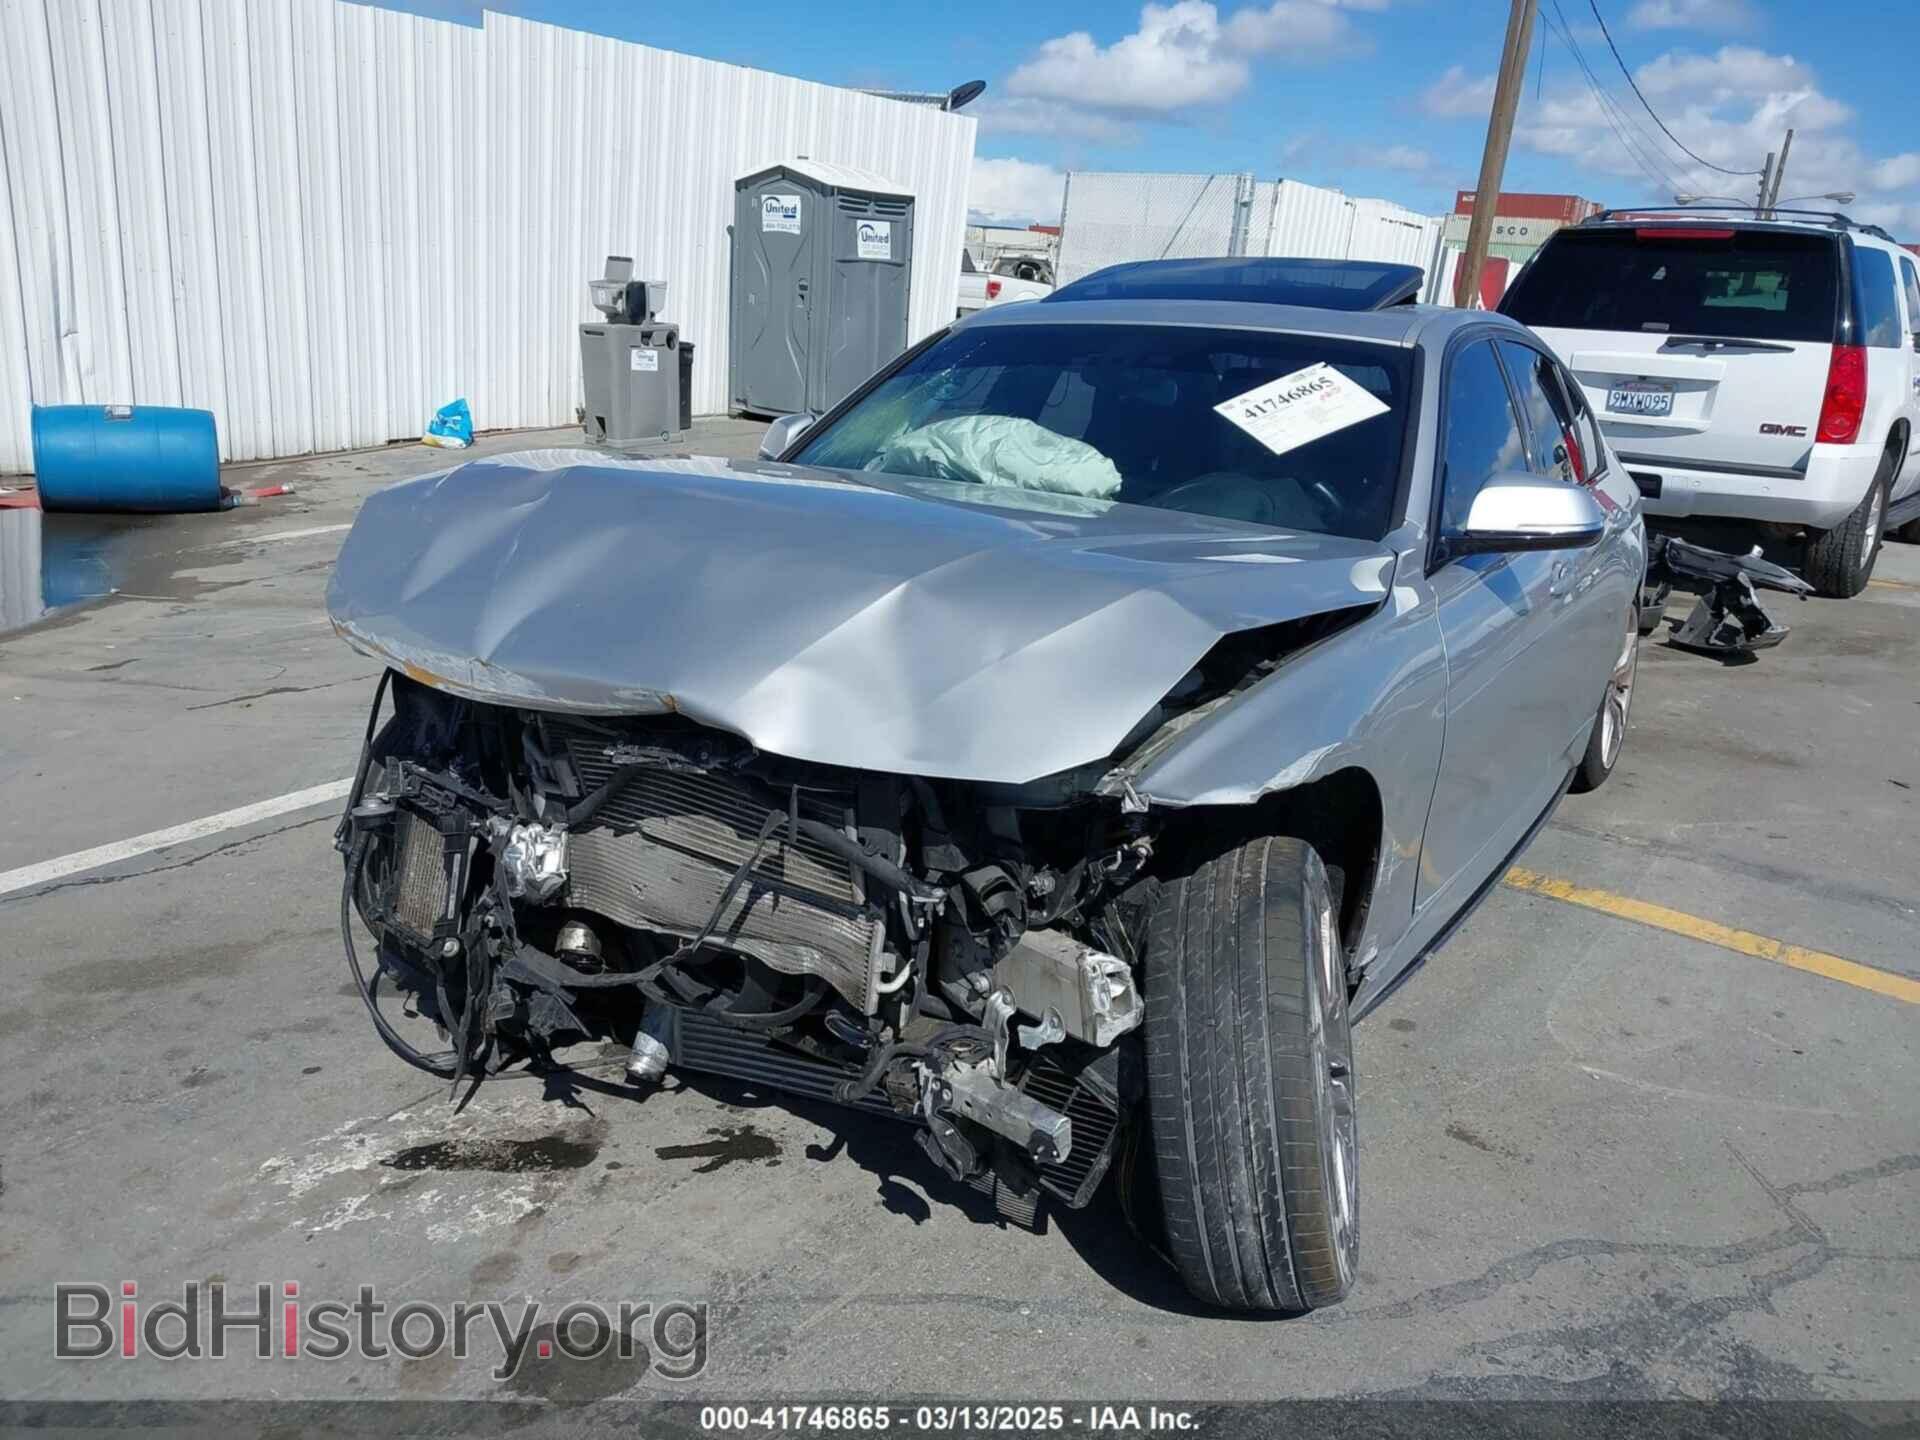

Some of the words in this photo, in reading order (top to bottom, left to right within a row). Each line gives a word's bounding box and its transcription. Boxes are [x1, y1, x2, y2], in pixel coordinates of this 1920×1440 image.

[765, 203, 797, 214] United
[861, 231, 889, 244] United
[1244, 376, 1335, 420] 41746865
[1608, 391, 1669, 411] 9MXW095
[1759, 423, 1807, 437] GMC
